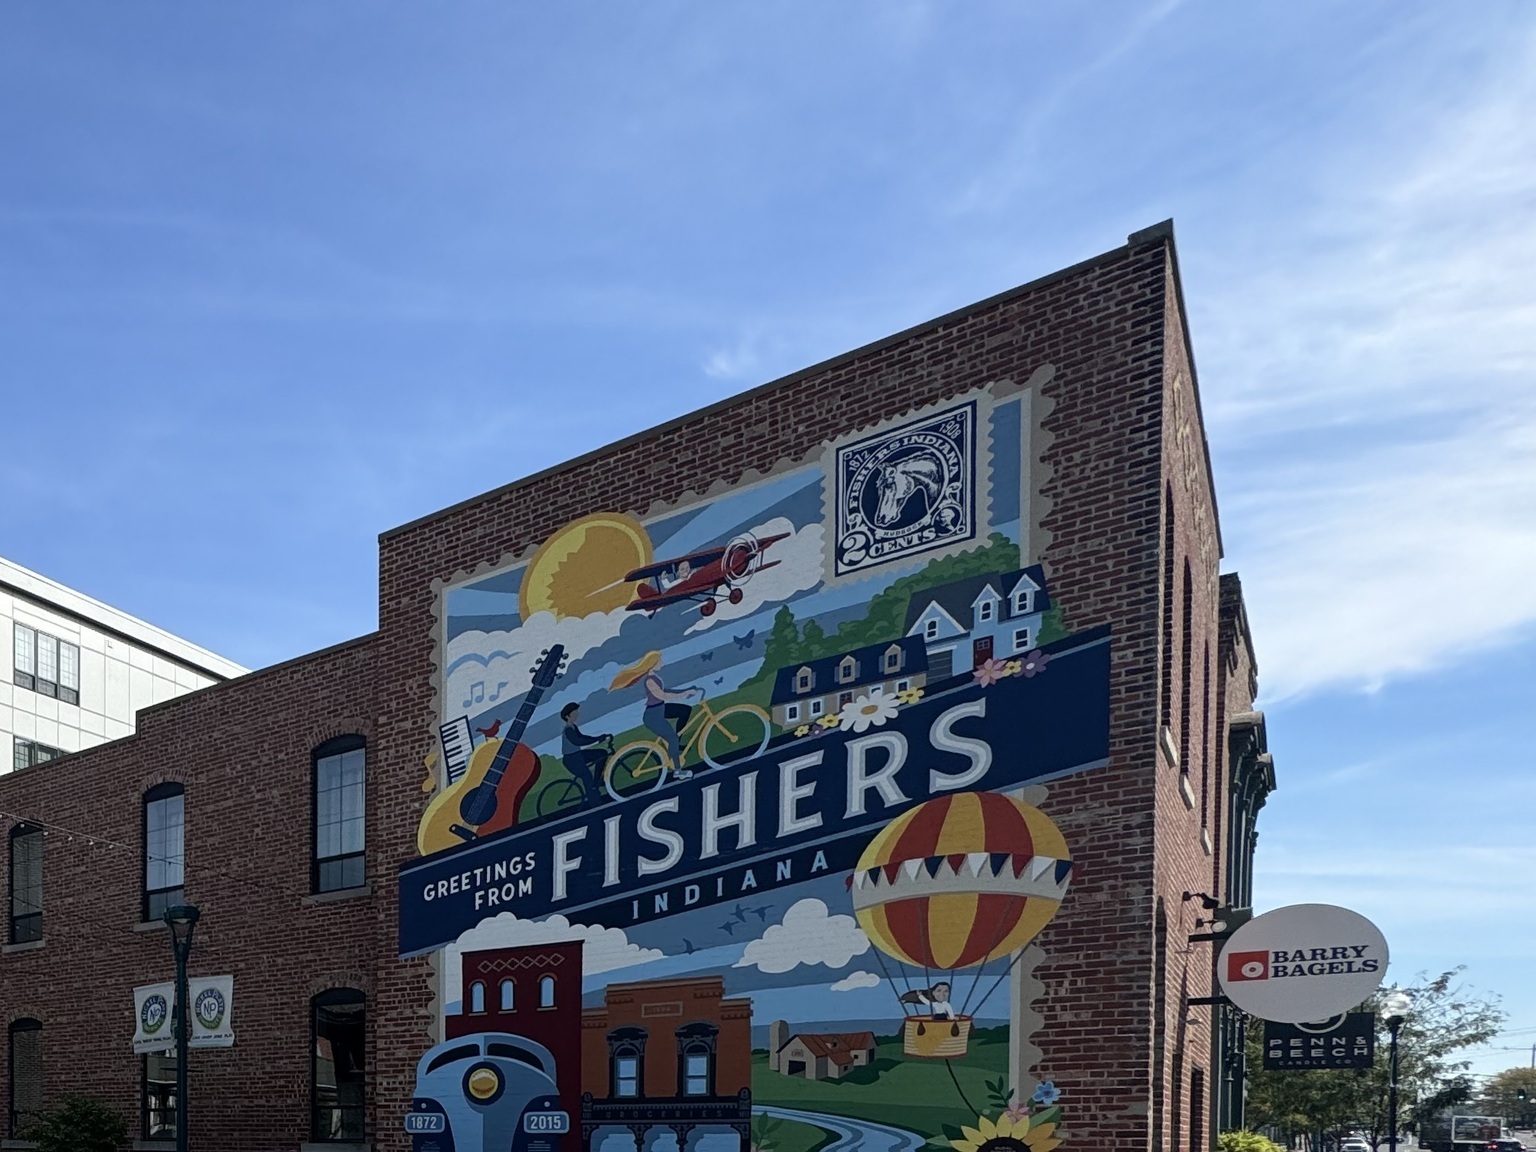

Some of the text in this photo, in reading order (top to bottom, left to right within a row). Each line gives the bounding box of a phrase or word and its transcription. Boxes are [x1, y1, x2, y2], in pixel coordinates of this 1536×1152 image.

[939, 420, 961, 440] 1908
[849, 451, 871, 472] 1872
[849, 435, 959, 508] FISHERS INDIANA
[842, 527, 936, 564] 2 CENTS
[551, 697, 994, 903] FISHERS
[423, 851, 537, 902] GREETINGS
[632, 849, 829, 919] INDIANA
[475, 876, 534, 910] FROM
[1271, 945, 1369, 963] BARRY
[1271, 959, 1379, 978] BAGELS
[203, 1001, 216, 1018] NP
[1269, 1036, 1367, 1048] PENN &
[1269, 1048, 1368, 1058] BEECH
[411, 1116, 437, 1129] 1872
[530, 1115, 562, 1130] 2015
[606, 1110, 722, 1119] GROCERIES
